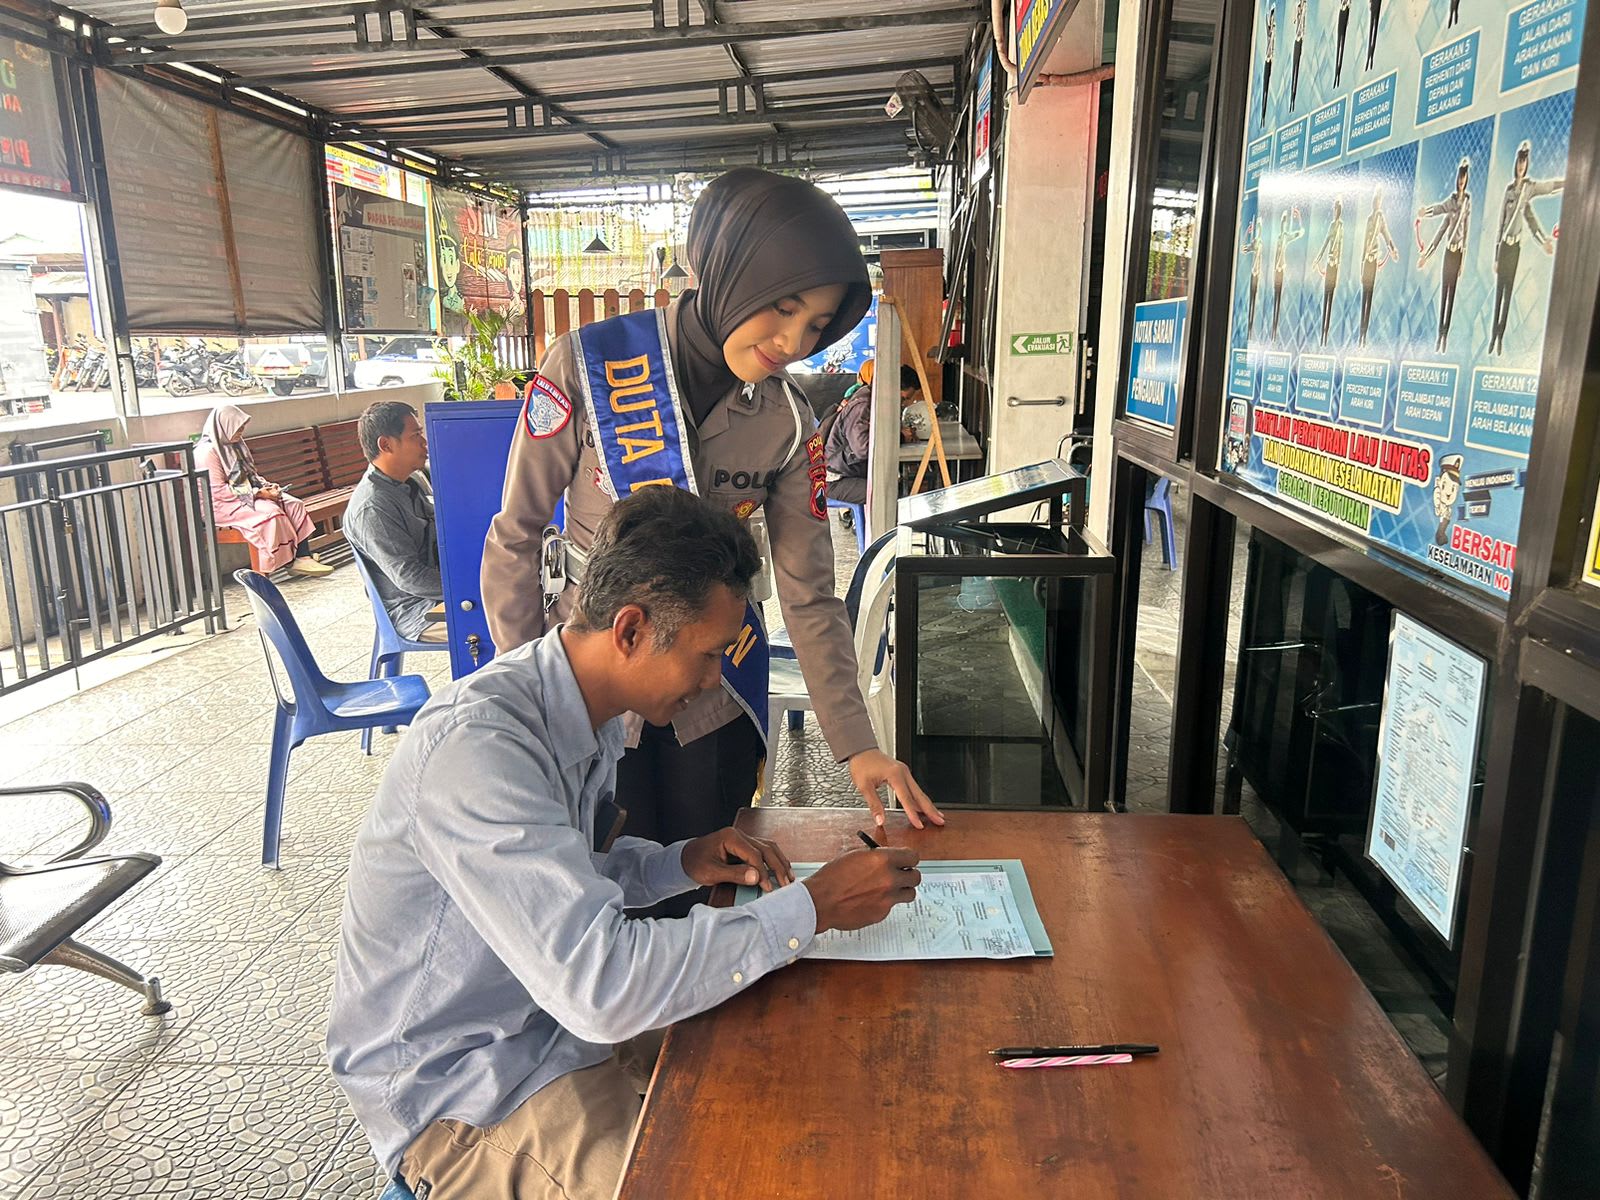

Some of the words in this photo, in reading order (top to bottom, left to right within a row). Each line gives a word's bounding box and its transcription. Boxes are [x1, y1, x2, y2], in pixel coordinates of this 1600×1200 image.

[1520, 20, 1548, 46] JALAN
[1548, 11, 1572, 33] DARI
[1430, 42, 1465, 69] GERAKAN
[1514, 46, 1540, 66] ARAH
[1521, 61, 1539, 79] DAN
[1540, 53, 1560, 71] KIRI
[1425, 66, 1454, 88] BERHENTI
[1455, 58, 1472, 75] DARI
[1359, 82, 1384, 102] GERAKAN
[1429, 82, 1448, 101] DEPAN
[1450, 77, 1464, 93] DAN
[1427, 94, 1461, 116] BELAKANG
[1364, 114, 1390, 133] BELAKANG
[1134, 320, 1153, 343] KOTAK
[1153, 319, 1174, 343] SARAN
[1027, 343, 1055, 351] EVAKUASI
[1144, 349, 1157, 373] DAN
[1407, 368, 1440, 382] GERAKAN
[1441, 371, 1449, 383] 11
[1482, 374, 1525, 391] GERAKAN
[1527, 378, 1537, 393] 12
[1131, 377, 1165, 406] PENGADUAN
[1346, 384, 1369, 395] PERCEPAT
[1370, 386, 1382, 397] DARI
[1351, 397, 1364, 407] ARAH
[1401, 391, 1435, 405] PERLAMBAT
[1435, 395, 1451, 408] DARI
[604, 353, 665, 465] DUTA
[1405, 406, 1422, 418] ARAH
[1422, 408, 1442, 422] DEPAN
[1473, 400, 1519, 418] PERLAMBAT
[1519, 406, 1535, 420] DAR
[1471, 417, 1492, 431] ARAH
[1493, 419, 1534, 438] BELAKAN
[1291, 418, 1349, 458] PERATURAN
[1349, 432, 1379, 468] LALU
[1379, 439, 1430, 482] LINTAS
[1263, 437, 1280, 464] DAN
[1279, 443, 1327, 482] BUDAYAKAN
[1327, 457, 1402, 509] KESELAMATAN
[1278, 471, 1312, 506] SEBAGAI
[1311, 483, 1369, 531] KEBUTUHAN
[1428, 545, 1492, 585] KESELAMATAN
